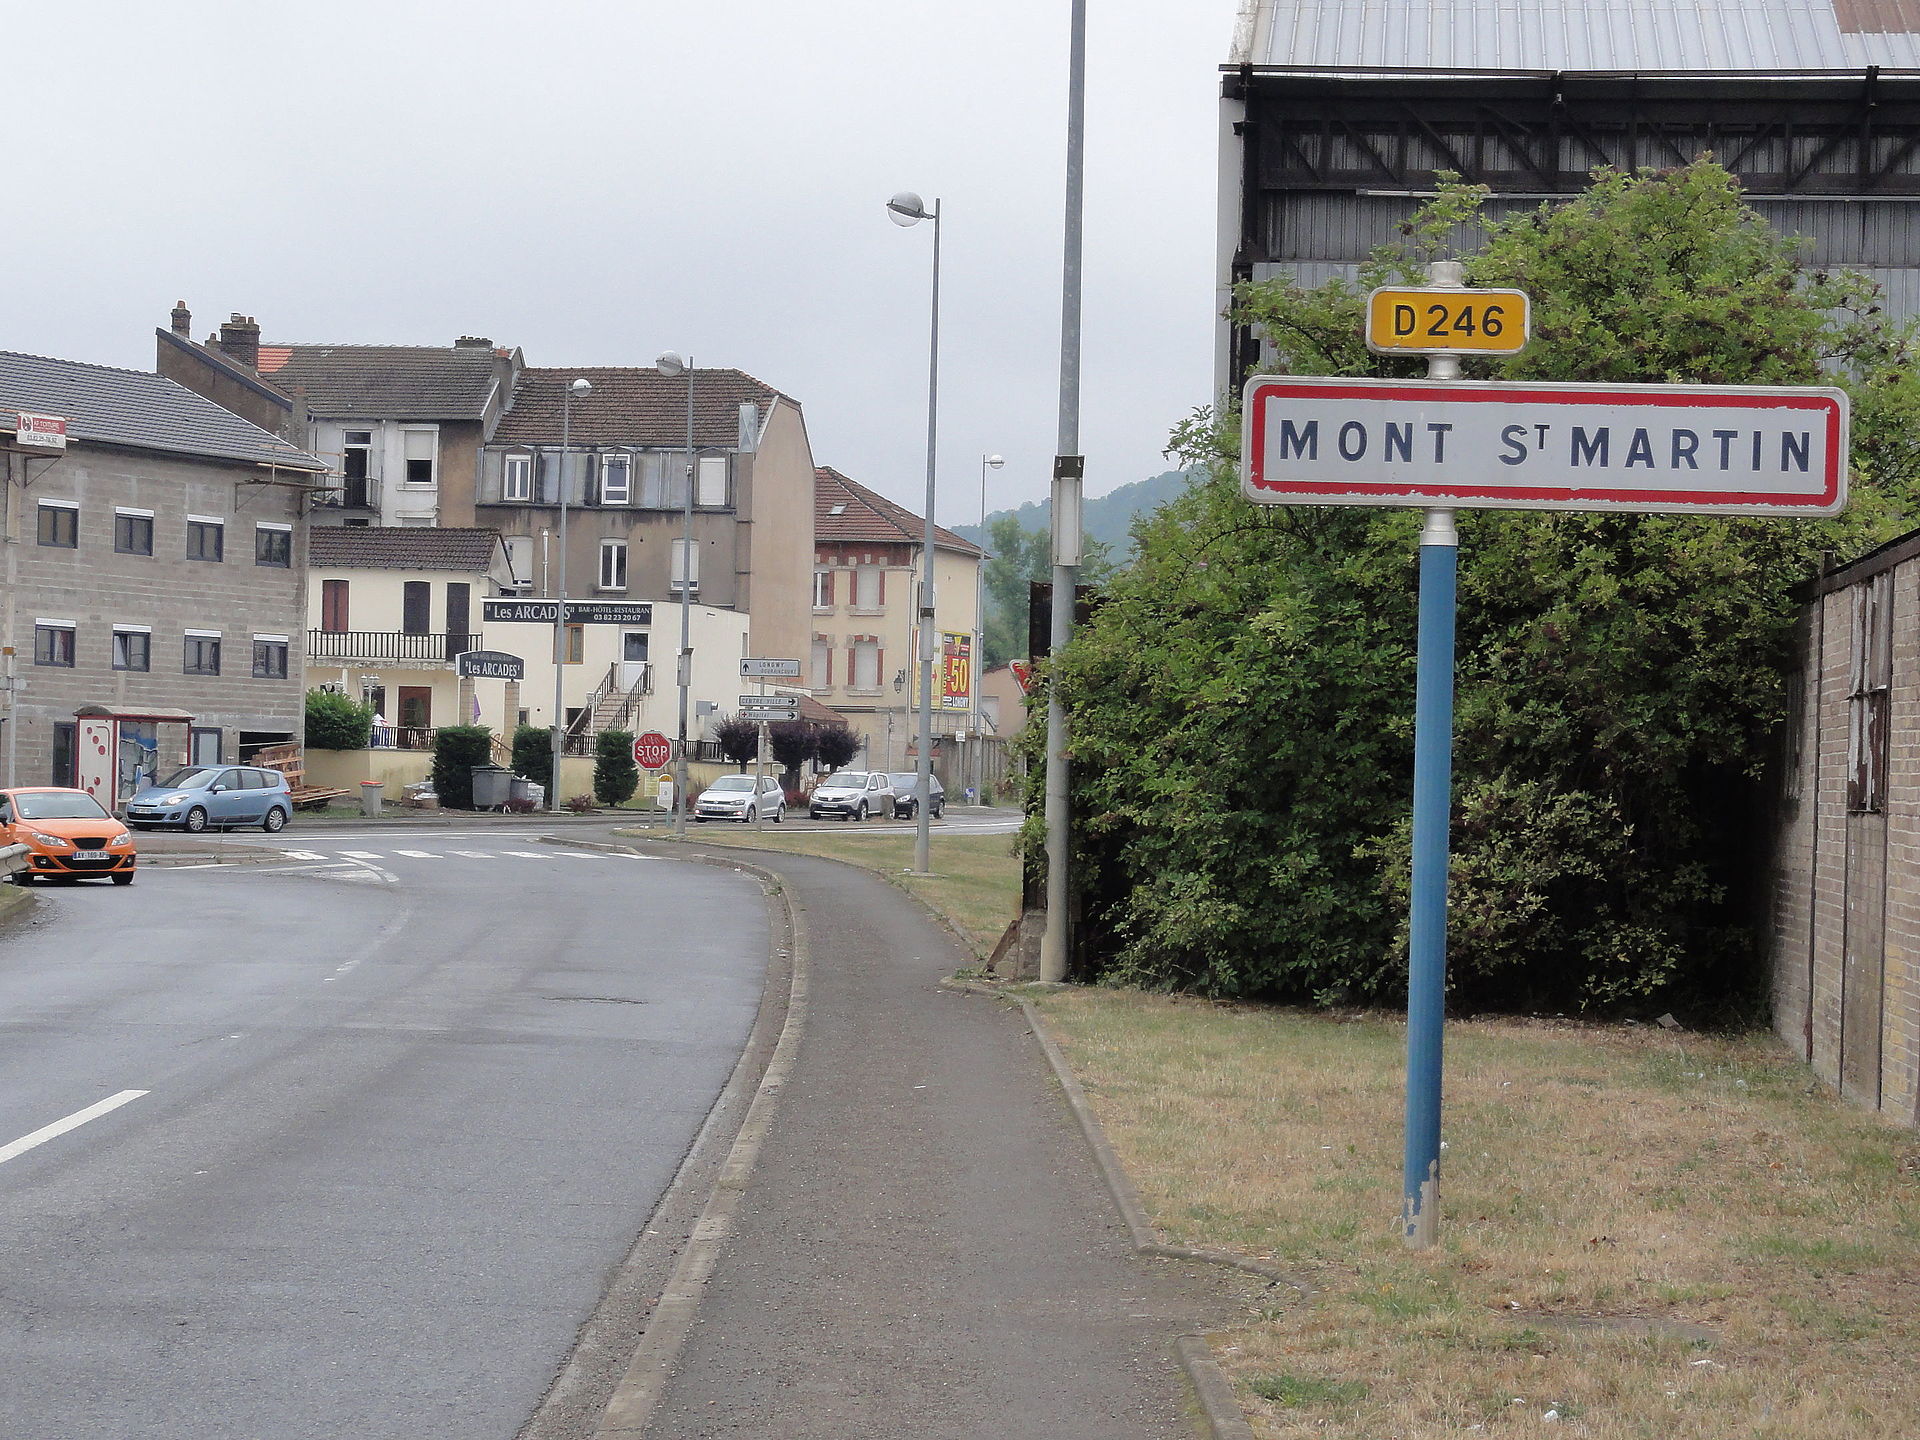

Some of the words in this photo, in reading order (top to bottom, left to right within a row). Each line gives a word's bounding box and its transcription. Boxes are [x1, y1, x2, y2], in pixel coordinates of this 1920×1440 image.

[1395, 304, 1416, 336] D
[1427, 304, 1505, 338] 246
[1280, 419, 1453, 464] MONT
[1570, 426, 1810, 473] MARTIN
[494, 605, 512, 619] Les
[514, 605, 575, 620] ARCADS"
[637, 745, 668, 757] STOP
